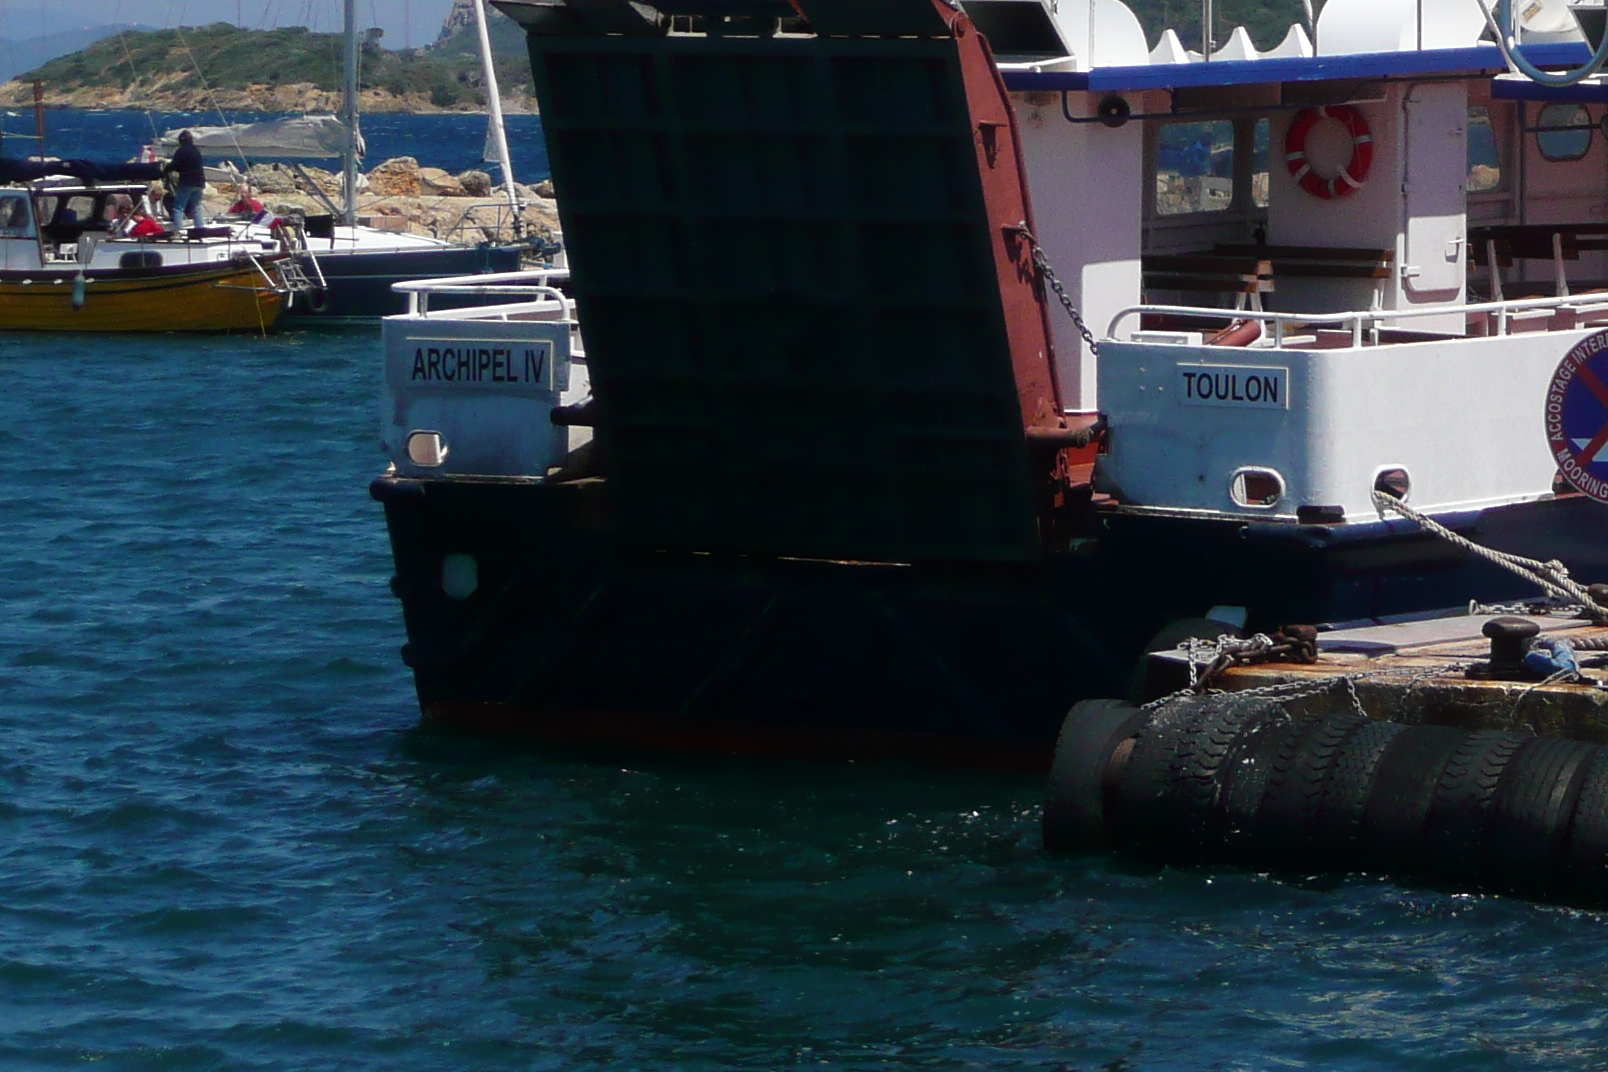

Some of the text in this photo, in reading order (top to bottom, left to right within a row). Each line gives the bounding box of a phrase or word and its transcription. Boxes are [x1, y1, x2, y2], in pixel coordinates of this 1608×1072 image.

[411, 347, 545, 383] ARCHIPEL IV
[1183, 372, 1278, 403] TOULON
[1548, 360, 1577, 441] ACCOSTAGE
[1556, 447, 1608, 499] MOORING
